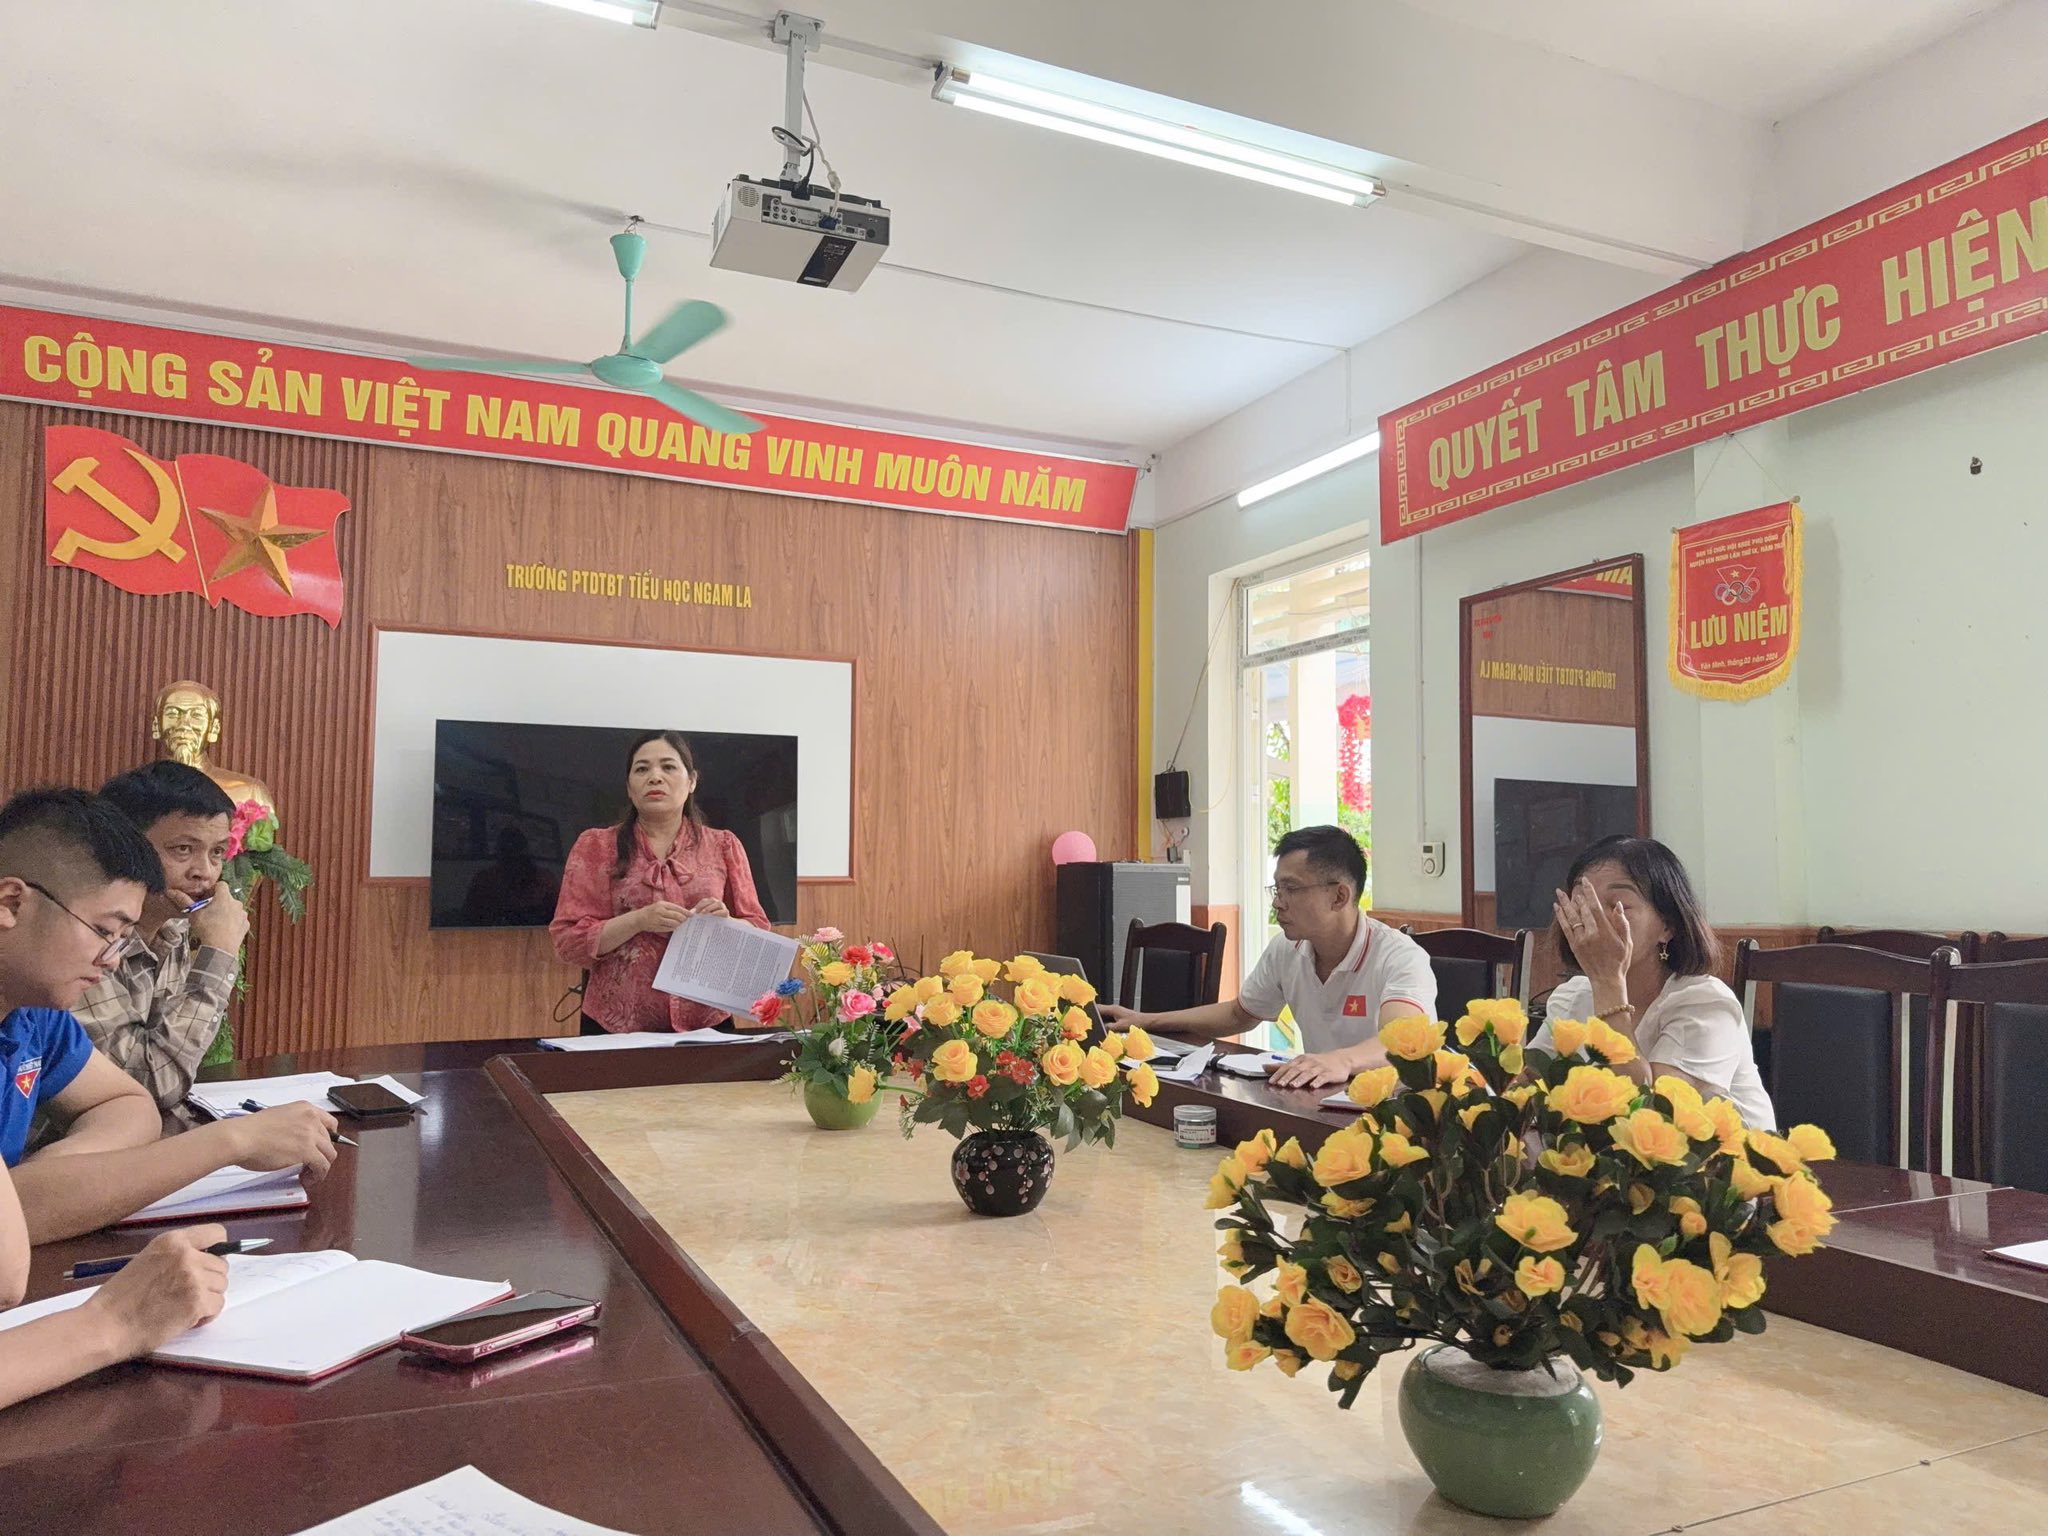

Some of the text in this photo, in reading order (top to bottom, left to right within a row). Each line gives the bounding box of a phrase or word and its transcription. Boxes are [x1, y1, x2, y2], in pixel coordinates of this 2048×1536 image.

[1428, 195, 2048, 489] QUYẾT TÂM THỰC HIỆN
[24, 332, 1087, 513] CỘNG SẢN VIỆT NAM QUANG VINH MUÔN NĂM
[506, 561, 567, 591] TRƯỜNG
[572, 570, 624, 597] PTDTBT
[664, 579, 690, 605] HỌC
[694, 582, 732, 607] NGAM
[736, 586, 752, 608] LA
[1690, 602, 1788, 650] LƯU NIỆM
